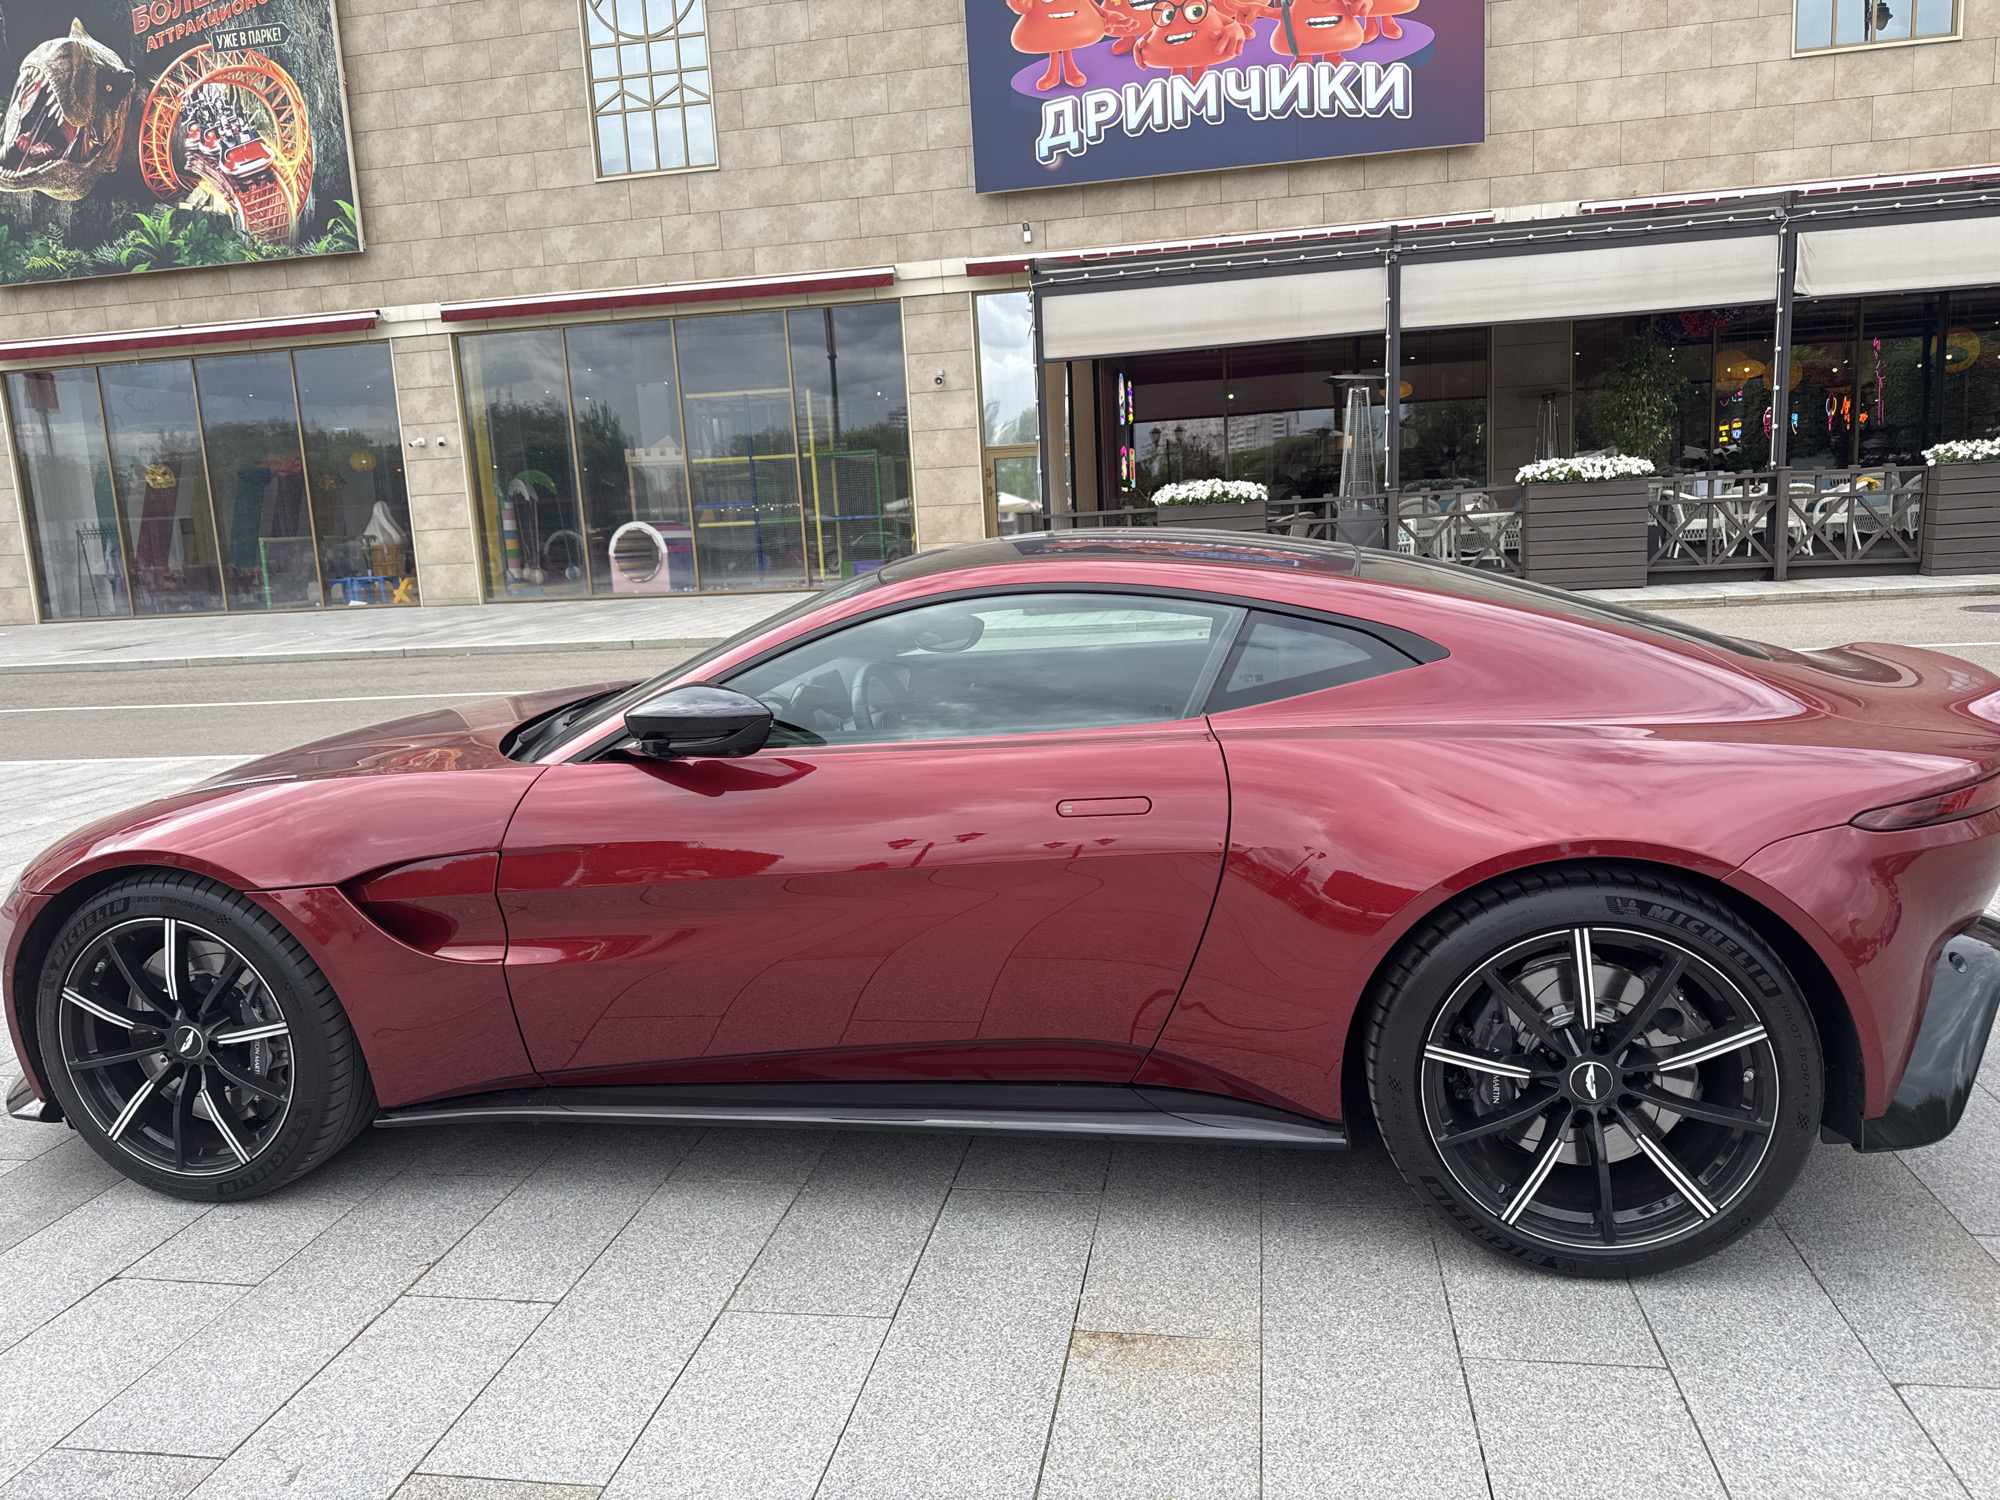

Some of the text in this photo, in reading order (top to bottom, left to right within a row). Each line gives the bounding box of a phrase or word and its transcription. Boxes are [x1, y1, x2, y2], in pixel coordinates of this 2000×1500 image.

[216, 27, 282, 49] УЖЕ В ПАРКЕ!
[1036, 62, 1412, 165] ДРИМЧИКИ
[54, 898, 126, 965] MICHELIN
[137, 895, 166, 904] PILOT
[166, 896, 200, 911] SPORT
[1646, 904, 1776, 991] MICHELIN
[1781, 1004, 1802, 1040] PILOT
[1797, 1046, 1811, 1090] SPORT
[253, 1055, 261, 1075] MARTI
[1492, 1074, 1501, 1105] MARTIN
[223, 1132, 300, 1194] MICHELIN
[1427, 1181, 1546, 1264] MICHELIN
